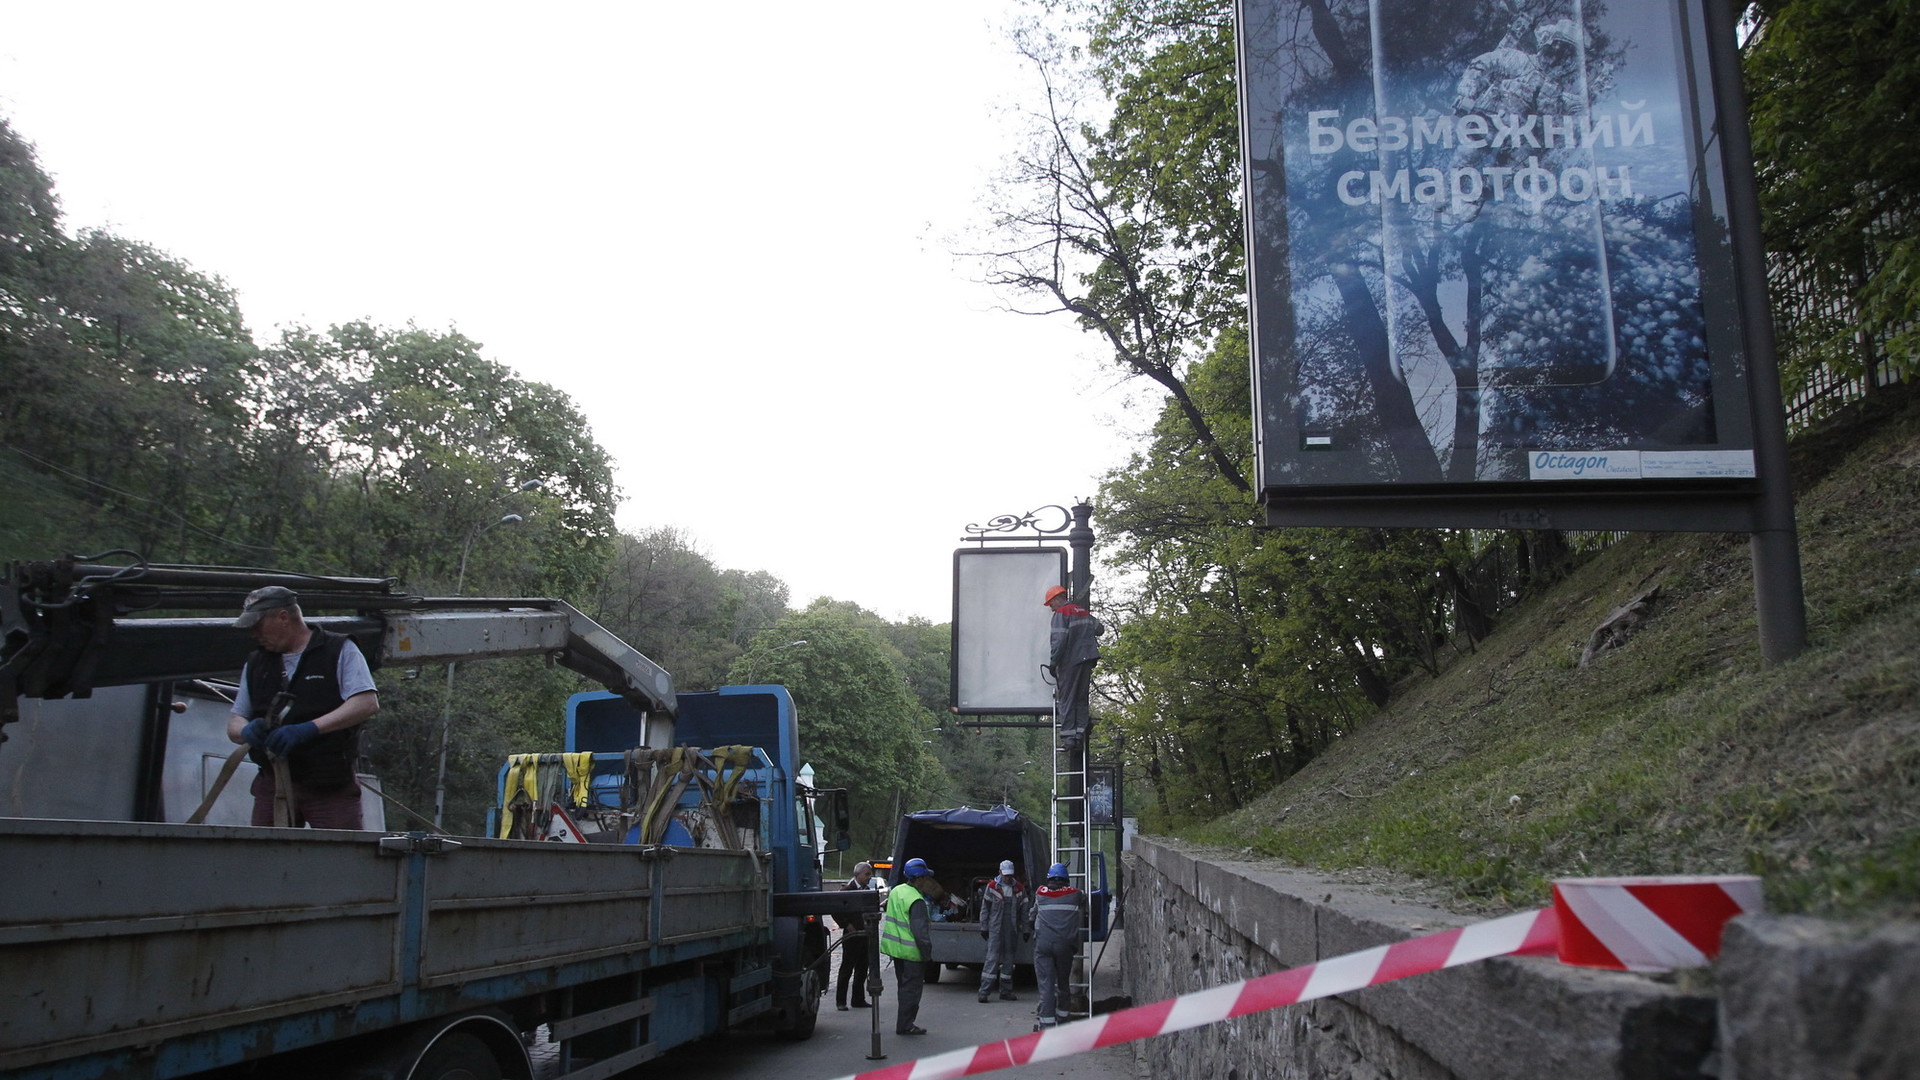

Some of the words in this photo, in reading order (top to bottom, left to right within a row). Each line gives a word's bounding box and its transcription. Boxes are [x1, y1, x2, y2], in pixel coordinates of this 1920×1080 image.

[1308, 100, 1655, 155] Безмежний
[1336, 155, 1633, 215] смартфон
[1535, 452, 1608, 475] Octagon
